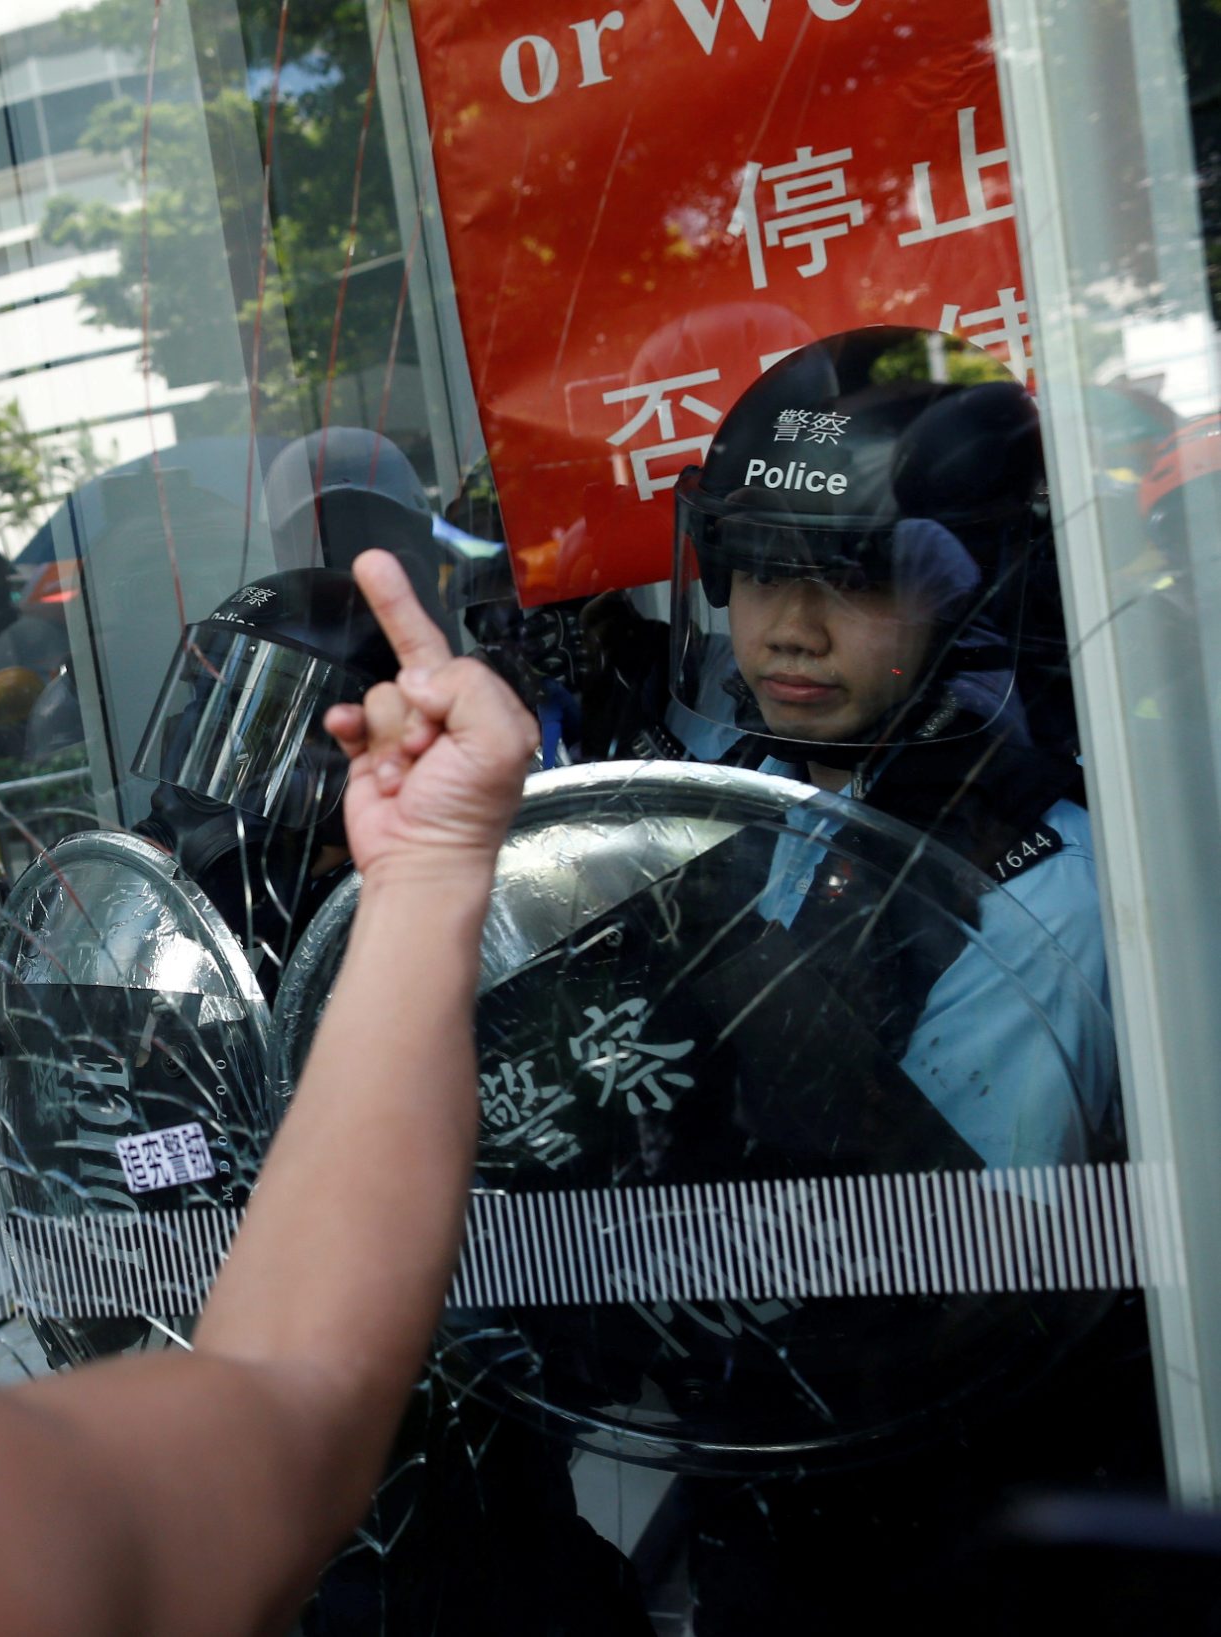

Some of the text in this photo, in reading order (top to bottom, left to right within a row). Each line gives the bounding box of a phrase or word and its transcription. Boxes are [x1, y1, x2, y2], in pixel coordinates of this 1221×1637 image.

[500, 0, 863, 103] or W
[727, 106, 1016, 289] 停止
[773, 409, 852, 445] 警察
[744, 459, 848, 495] Police
[995, 832, 1052, 878] 1644
[476, 998, 695, 1170] 警察
